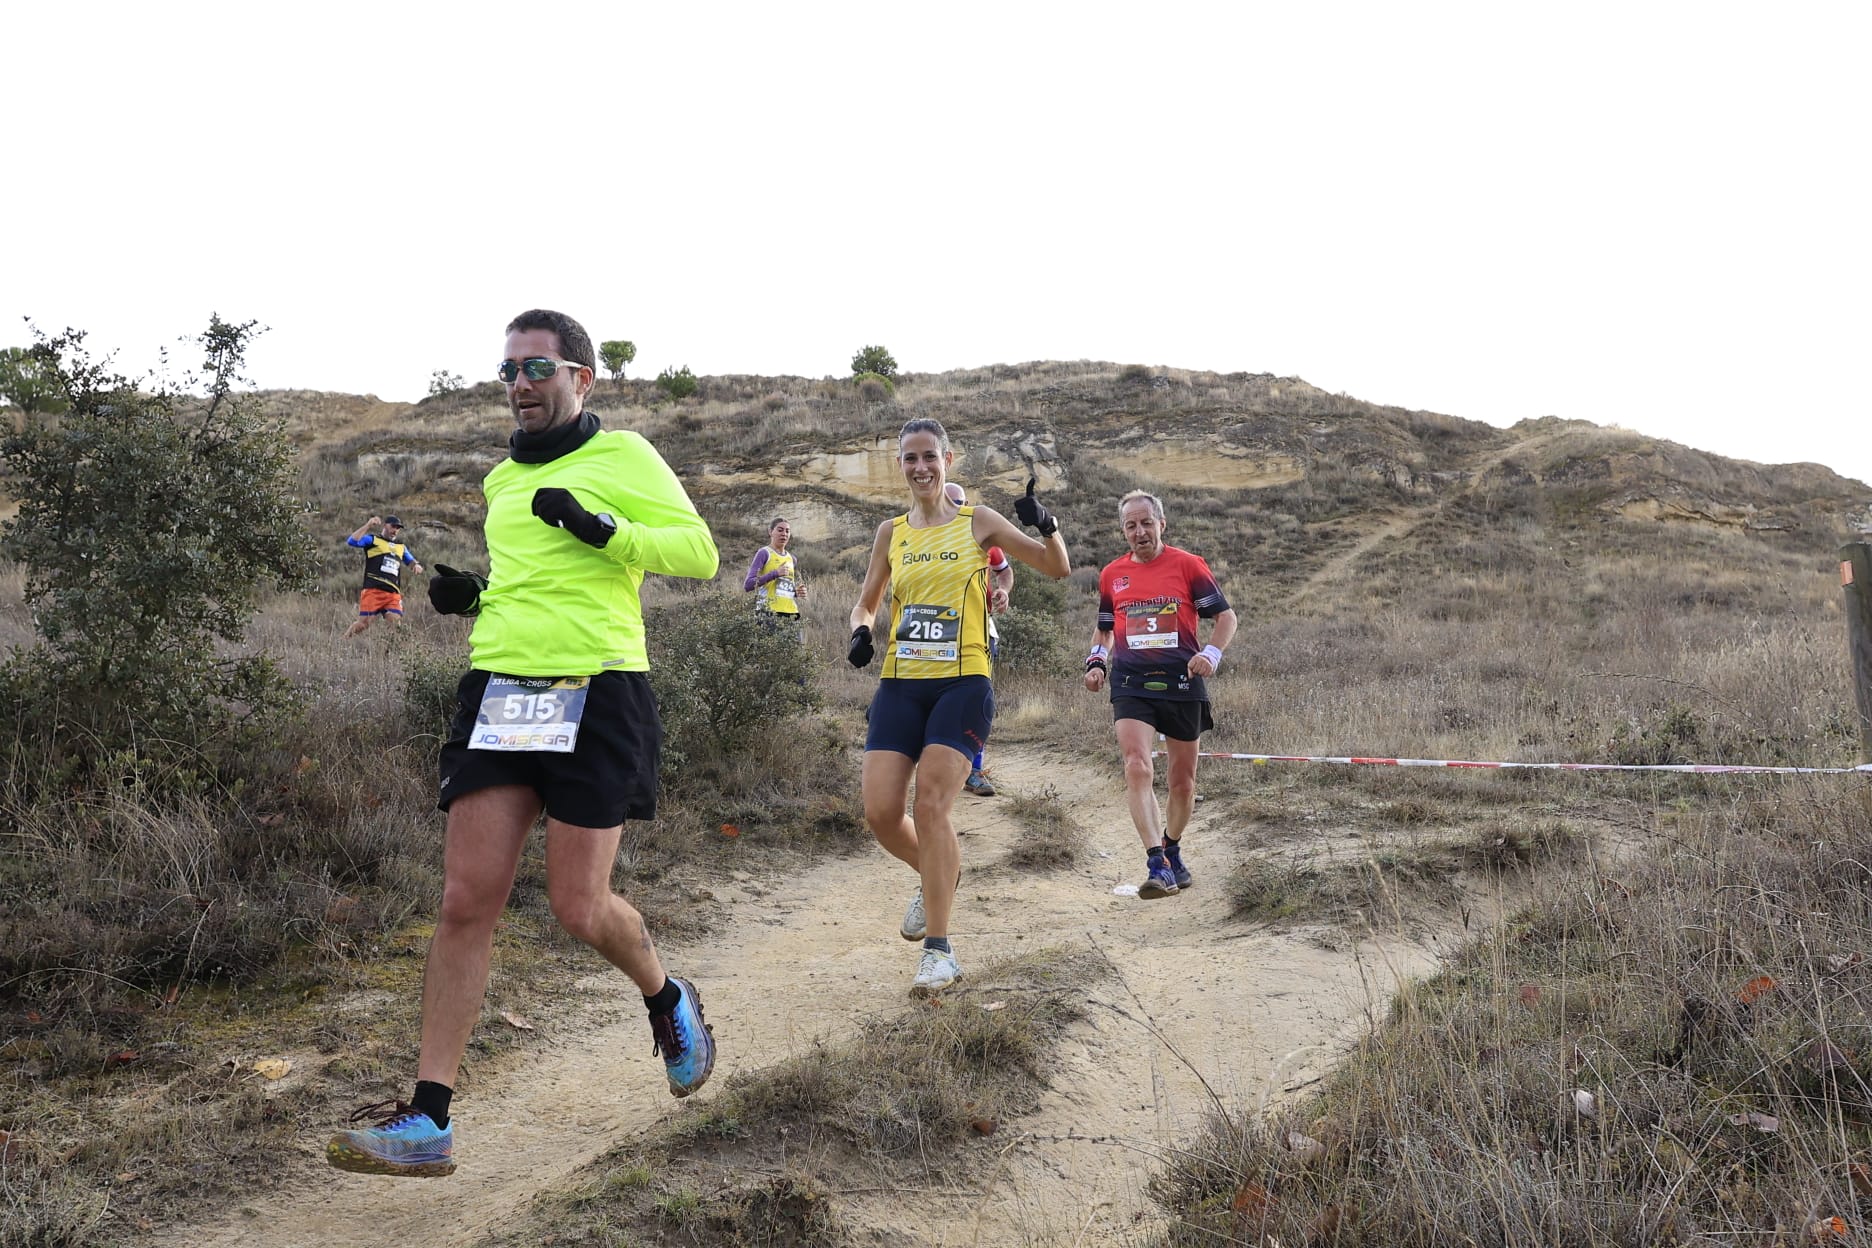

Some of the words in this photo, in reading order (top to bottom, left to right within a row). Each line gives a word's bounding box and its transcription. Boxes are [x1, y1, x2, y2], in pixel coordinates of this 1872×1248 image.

[903, 553, 931, 565] RUN
[940, 552, 959, 561] GO
[909, 620, 943, 639] 216
[1146, 617, 1158, 632] 3
[491, 678, 503, 686] 33
[502, 678, 520, 686] LIGA
[503, 694, 557, 720] 515
[474, 734, 569, 746] JOMISAGA
